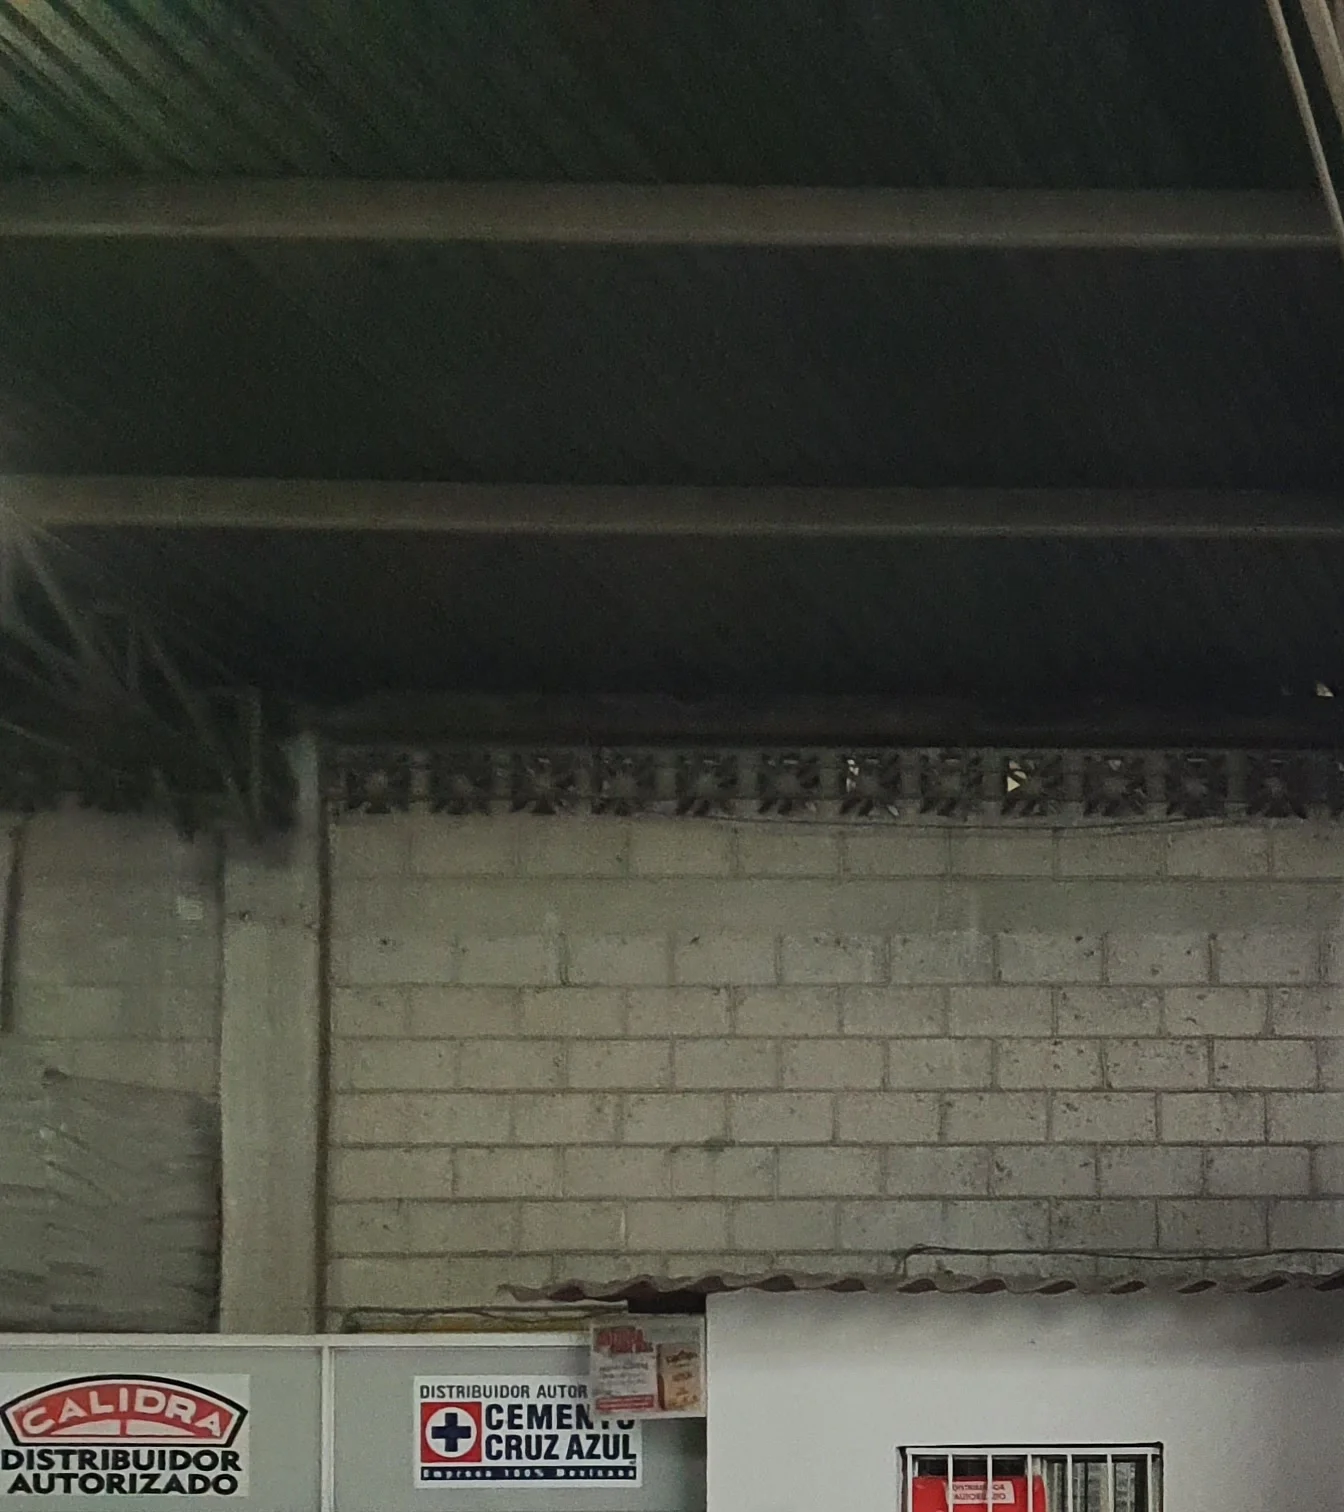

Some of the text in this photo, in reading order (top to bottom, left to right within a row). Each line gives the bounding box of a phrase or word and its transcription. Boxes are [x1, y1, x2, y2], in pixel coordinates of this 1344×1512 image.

[420, 1385, 530, 1399] DISTRIBUIDOR
[22, 1388, 221, 1437] CALIDRA
[485, 1434, 637, 1460] CRUZ AZUL
[1, 1449, 242, 1471] DISTRIBUIDOR
[7, 1473, 238, 1495] AUTORIZADO
